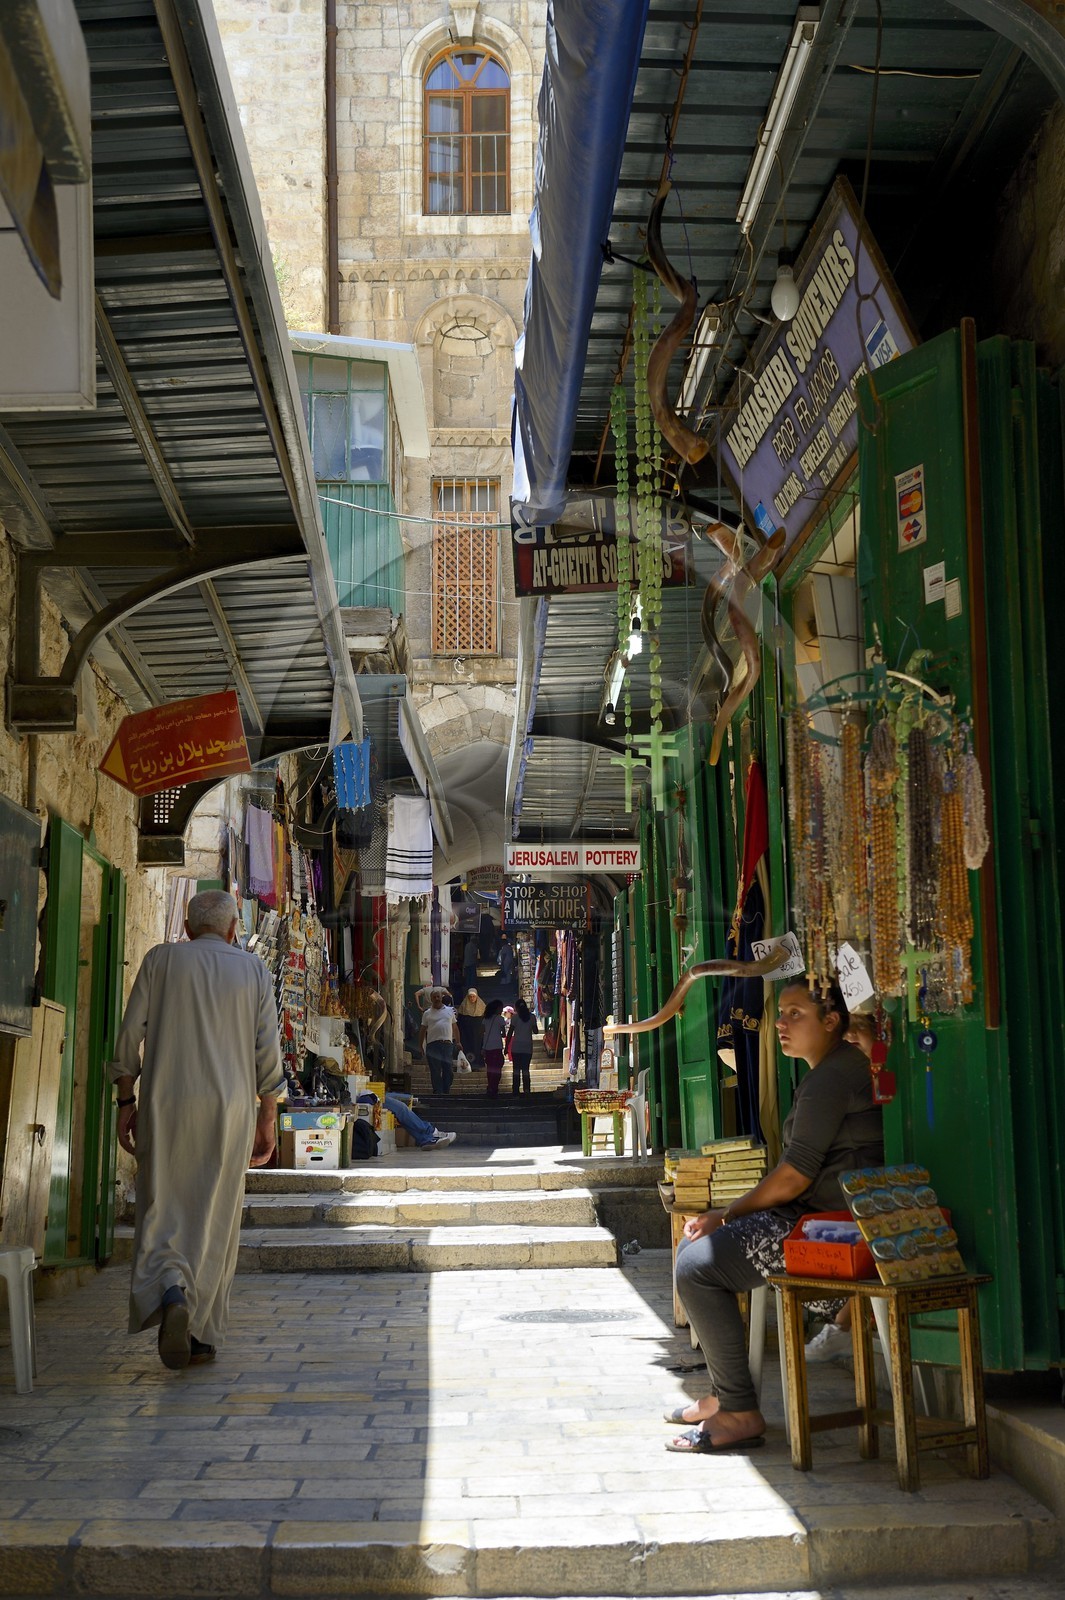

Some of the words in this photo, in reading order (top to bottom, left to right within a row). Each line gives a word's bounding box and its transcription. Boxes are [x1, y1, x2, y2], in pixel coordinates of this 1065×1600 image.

[726, 346, 798, 470] NASHASHIBI
[786, 229, 856, 374] SOUVENIRS
[176, 740, 204, 767] بلال
[205, 734, 246, 758] مسجد
[130, 756, 157, 784] رباح
[159, 750, 175, 772] بن
[508, 850, 579, 867] JERUSALEM
[585, 850, 638, 866] POTTERY
[504, 886, 536, 899] STOP
[539, 889, 546, 898] &
[550, 886, 588, 898] SHOP
[513, 899, 540, 919] MIKE
